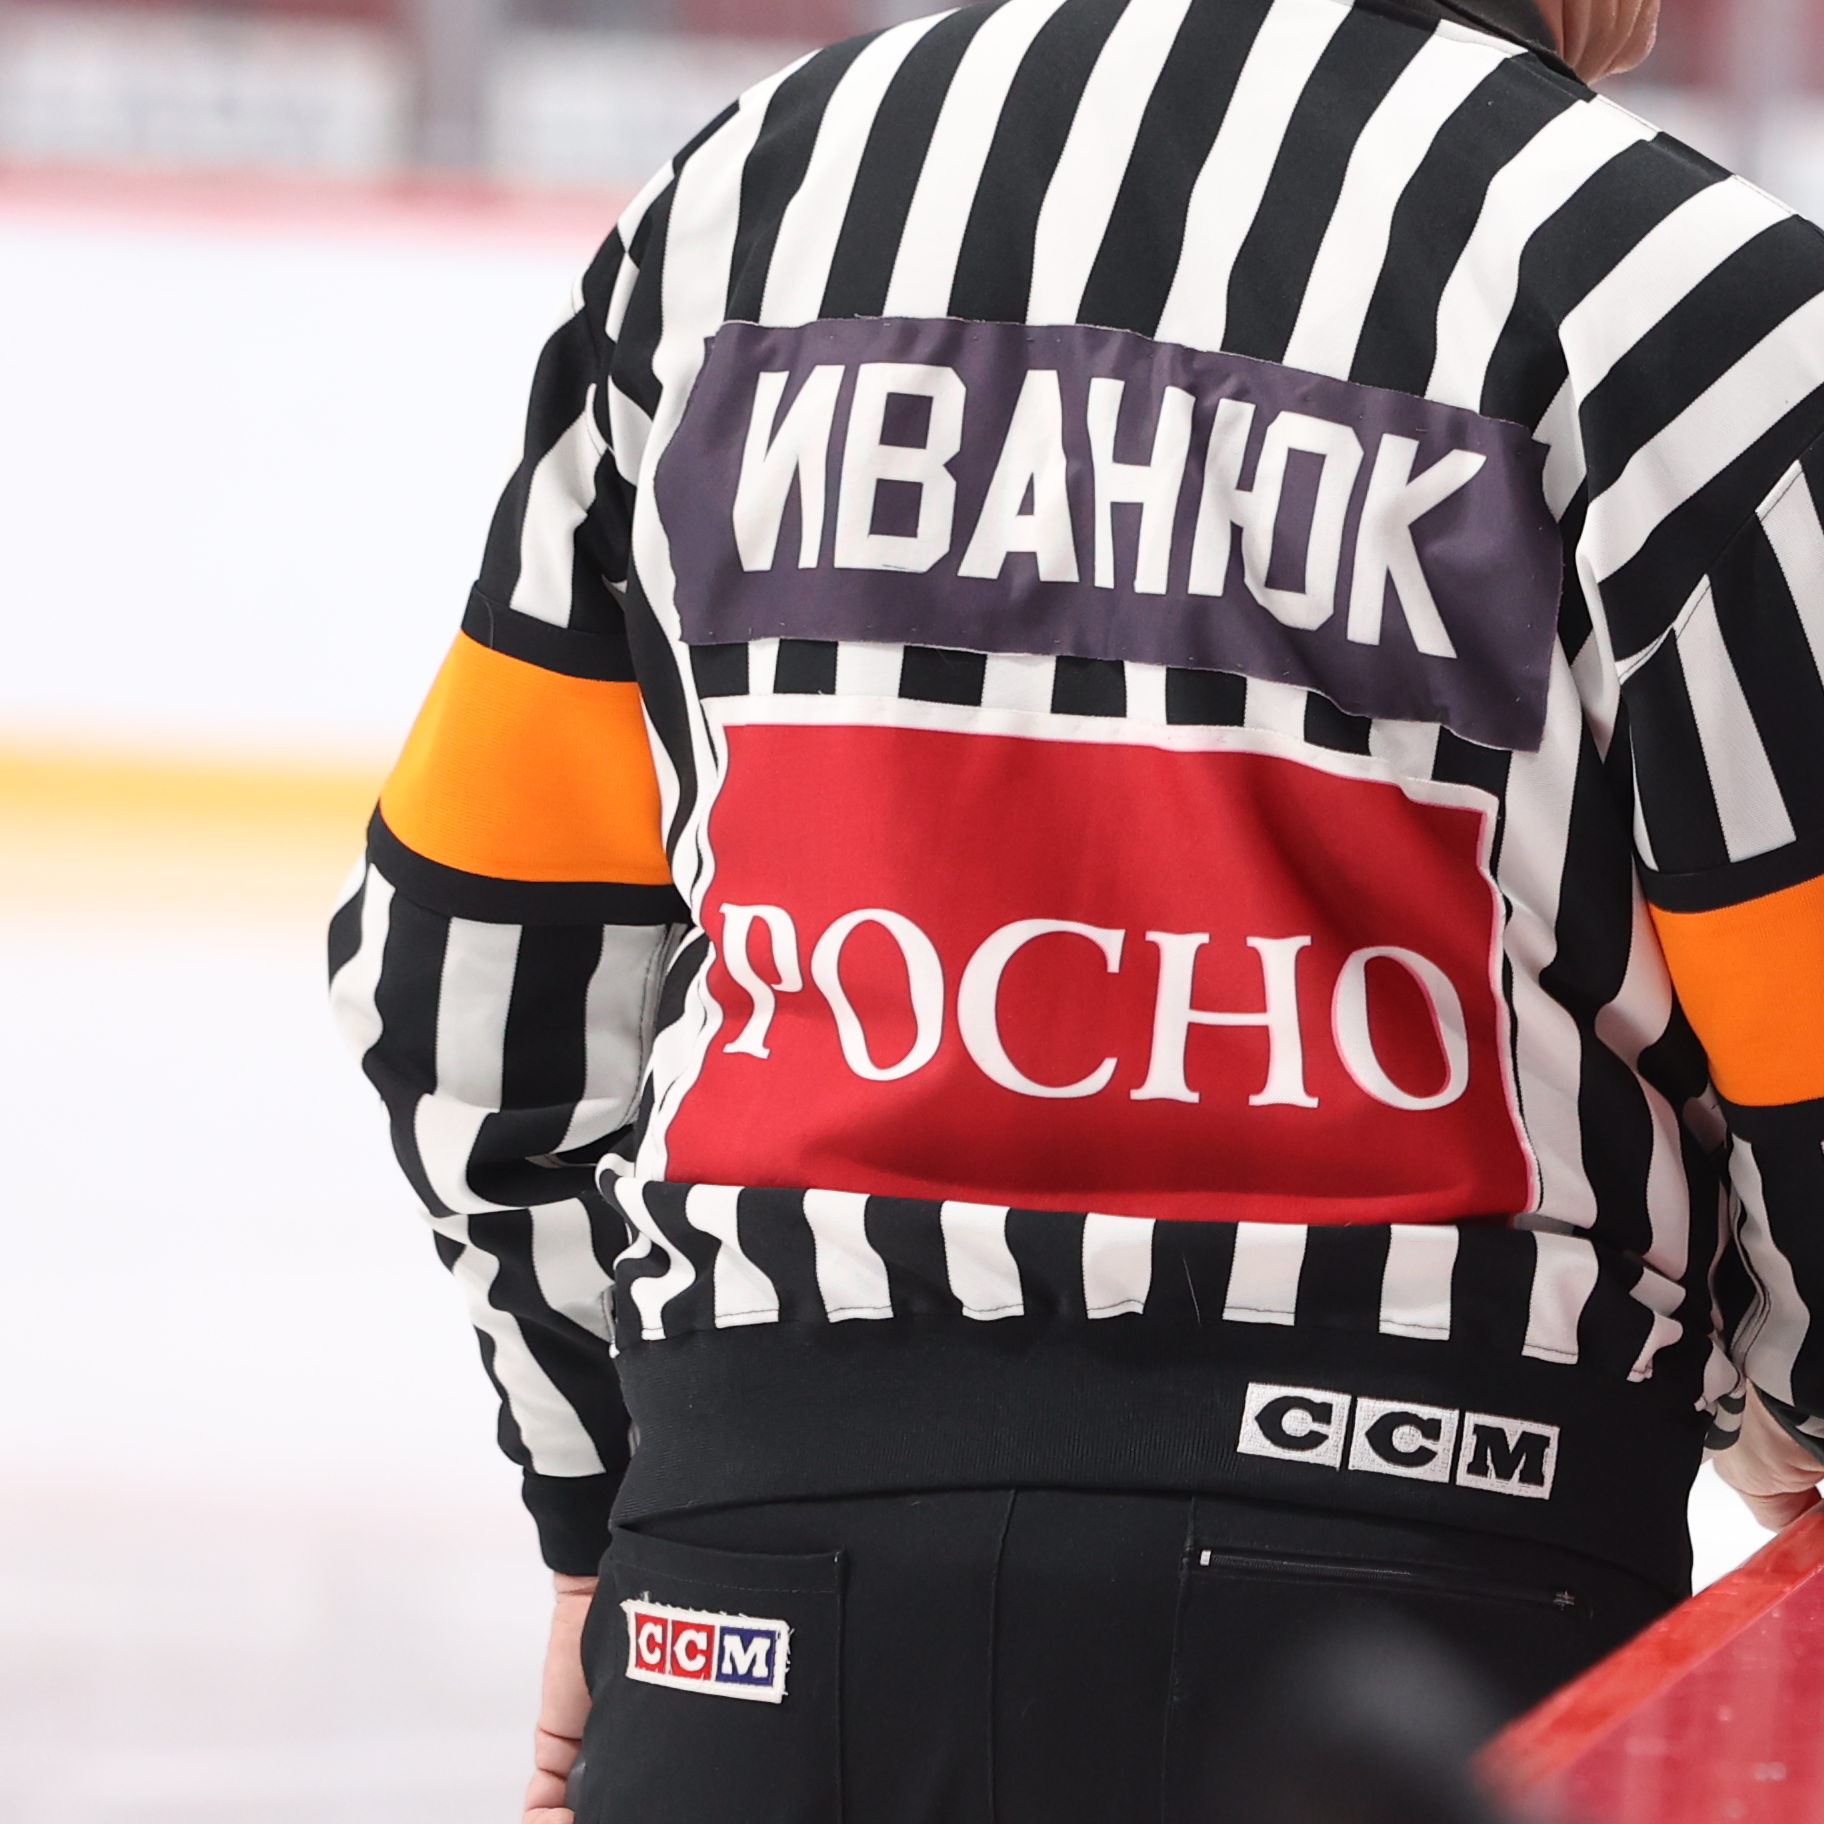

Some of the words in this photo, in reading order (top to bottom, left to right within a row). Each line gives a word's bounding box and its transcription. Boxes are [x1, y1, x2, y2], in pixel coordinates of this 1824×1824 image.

[732, 360, 1487, 659] ИВАНЮК
[718, 902, 1469, 1110] РОСНО
[1253, 1394, 1552, 1488] CCM
[637, 1621, 772, 1679] CCM
